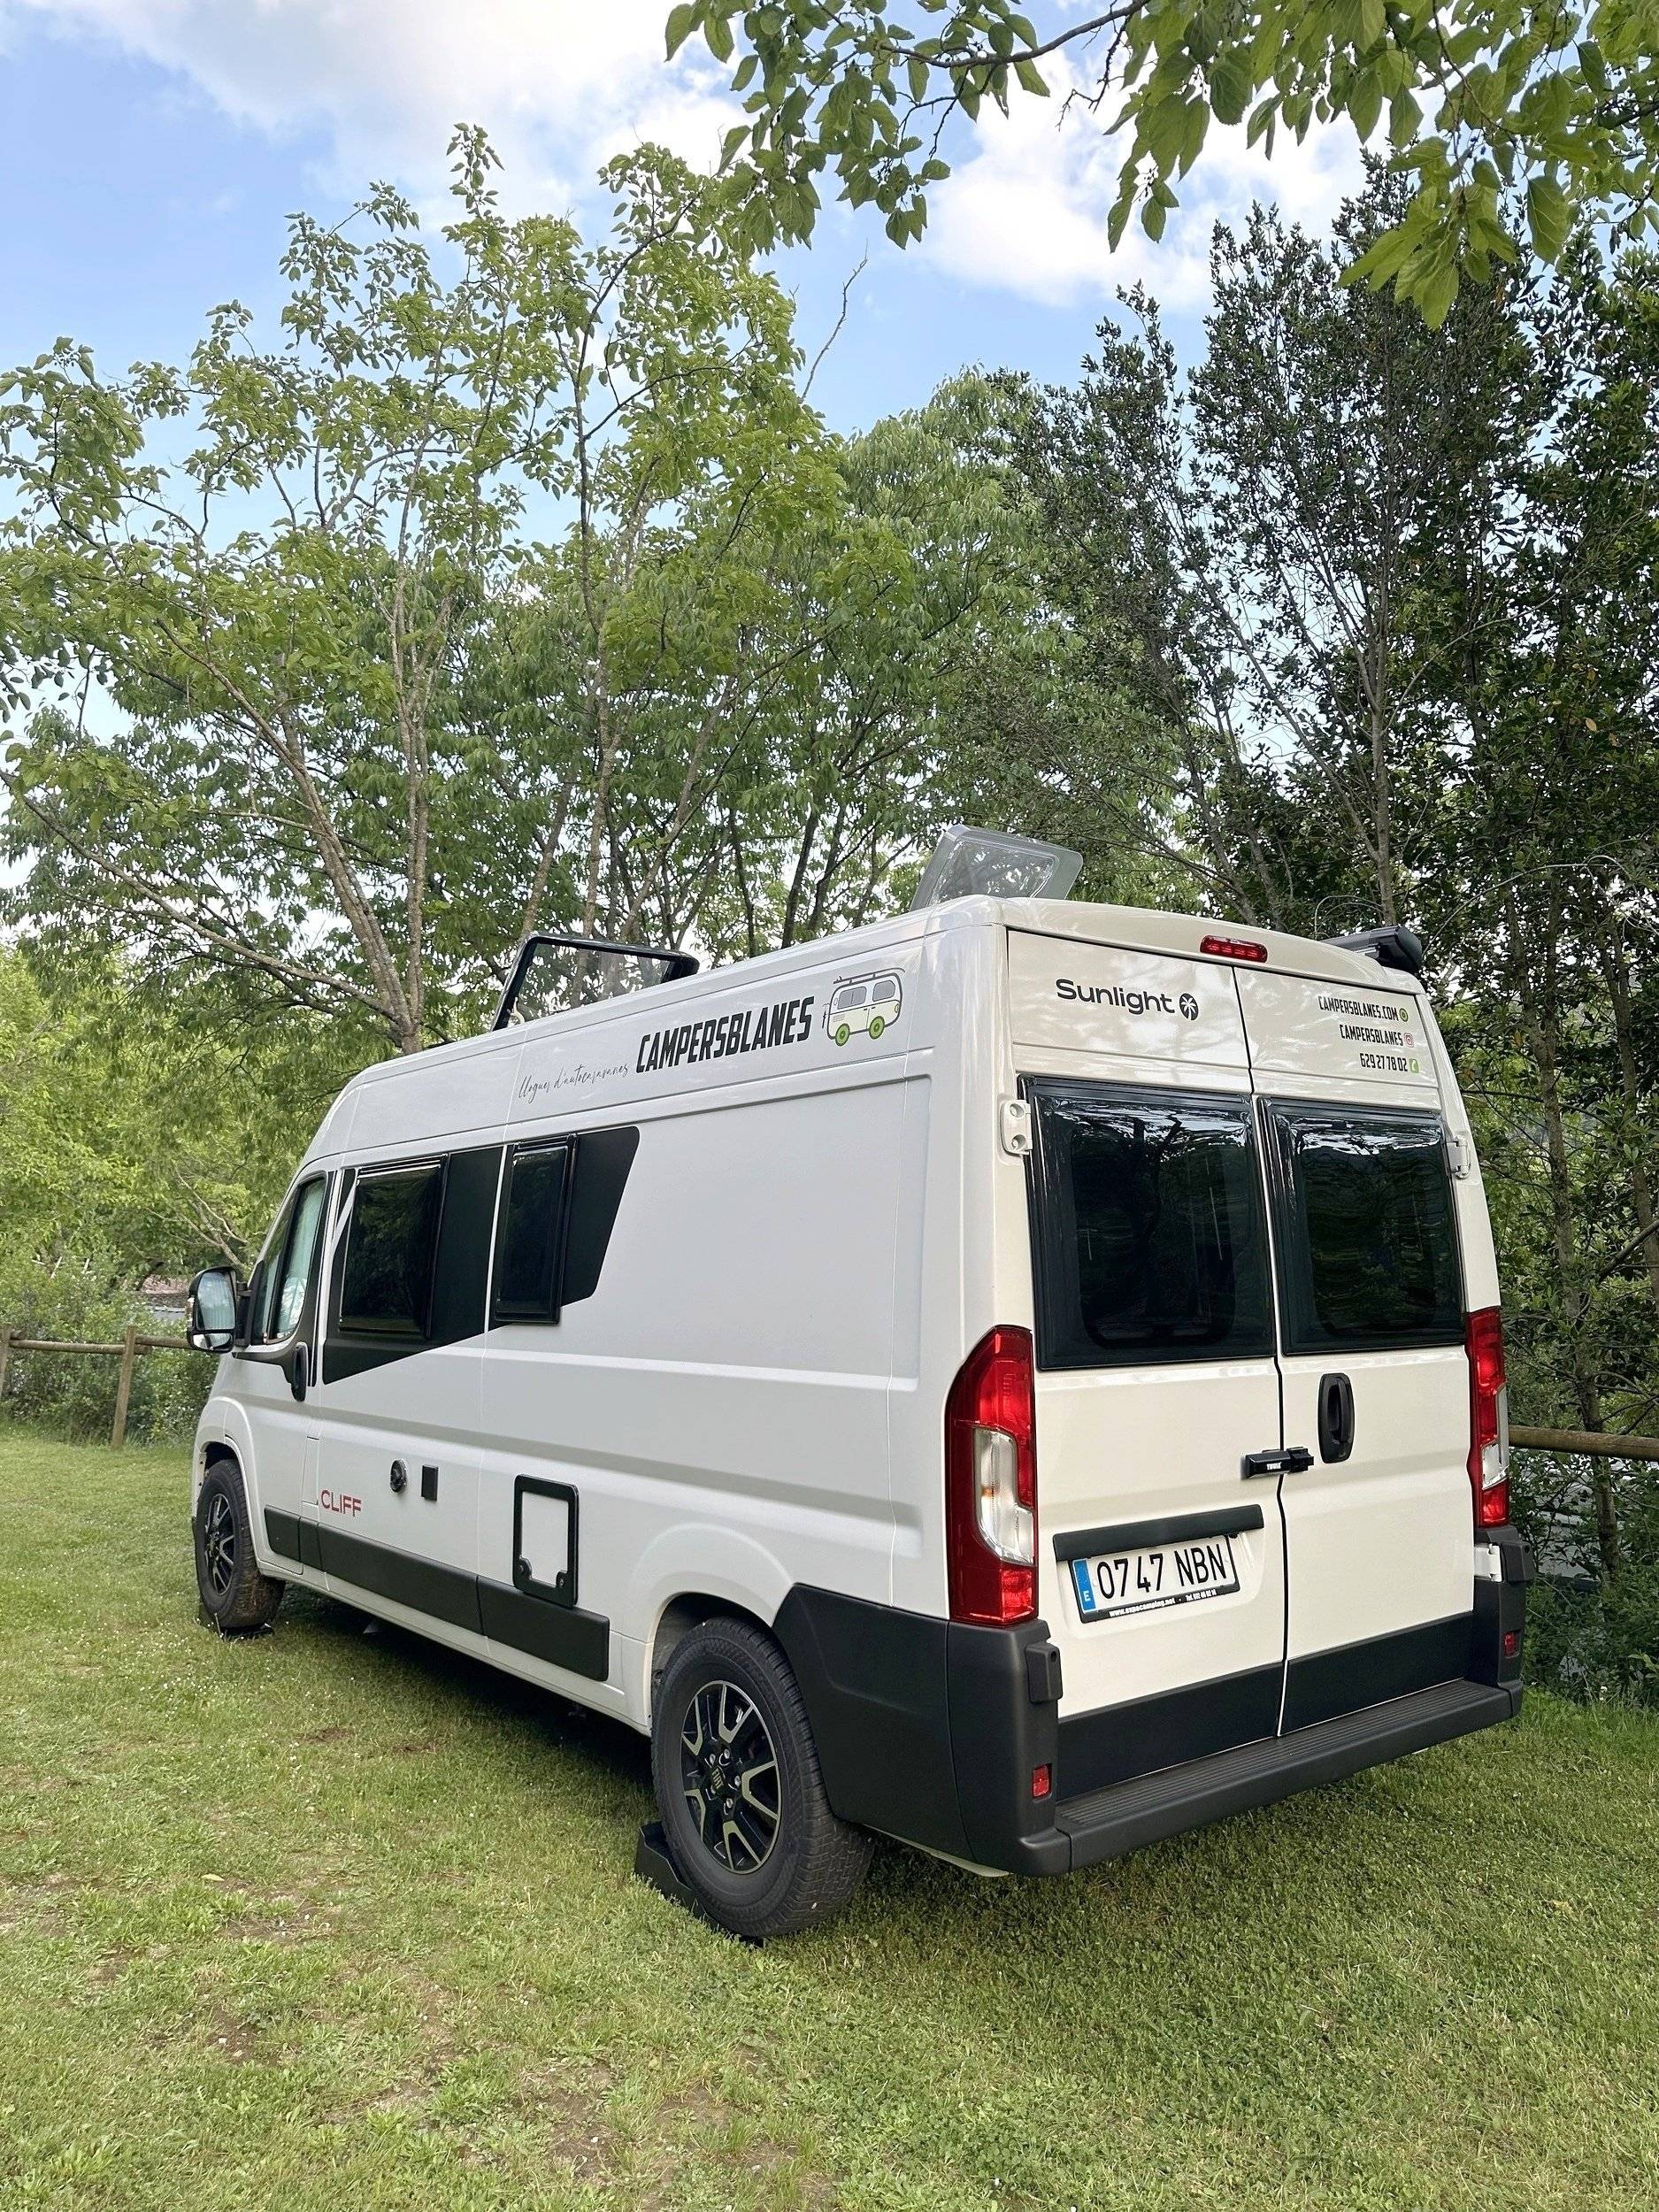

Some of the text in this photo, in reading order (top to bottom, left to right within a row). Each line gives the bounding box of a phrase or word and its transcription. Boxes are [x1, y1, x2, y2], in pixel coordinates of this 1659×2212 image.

[1056, 979, 1175, 1015] Sunlight
[1317, 995, 1400, 1021] CAMPERSBLANES.COM
[635, 996, 815, 1073] CAMPERSBLANES
[1339, 1024, 1403, 1046] CAMPERSBLANES
[321, 1489, 362, 1517] CLIFF
[1096, 1543, 1227, 1600] 0747 NBN
[1084, 1590, 1091, 1601] E
[711, 1768, 724, 1789] FIAT
